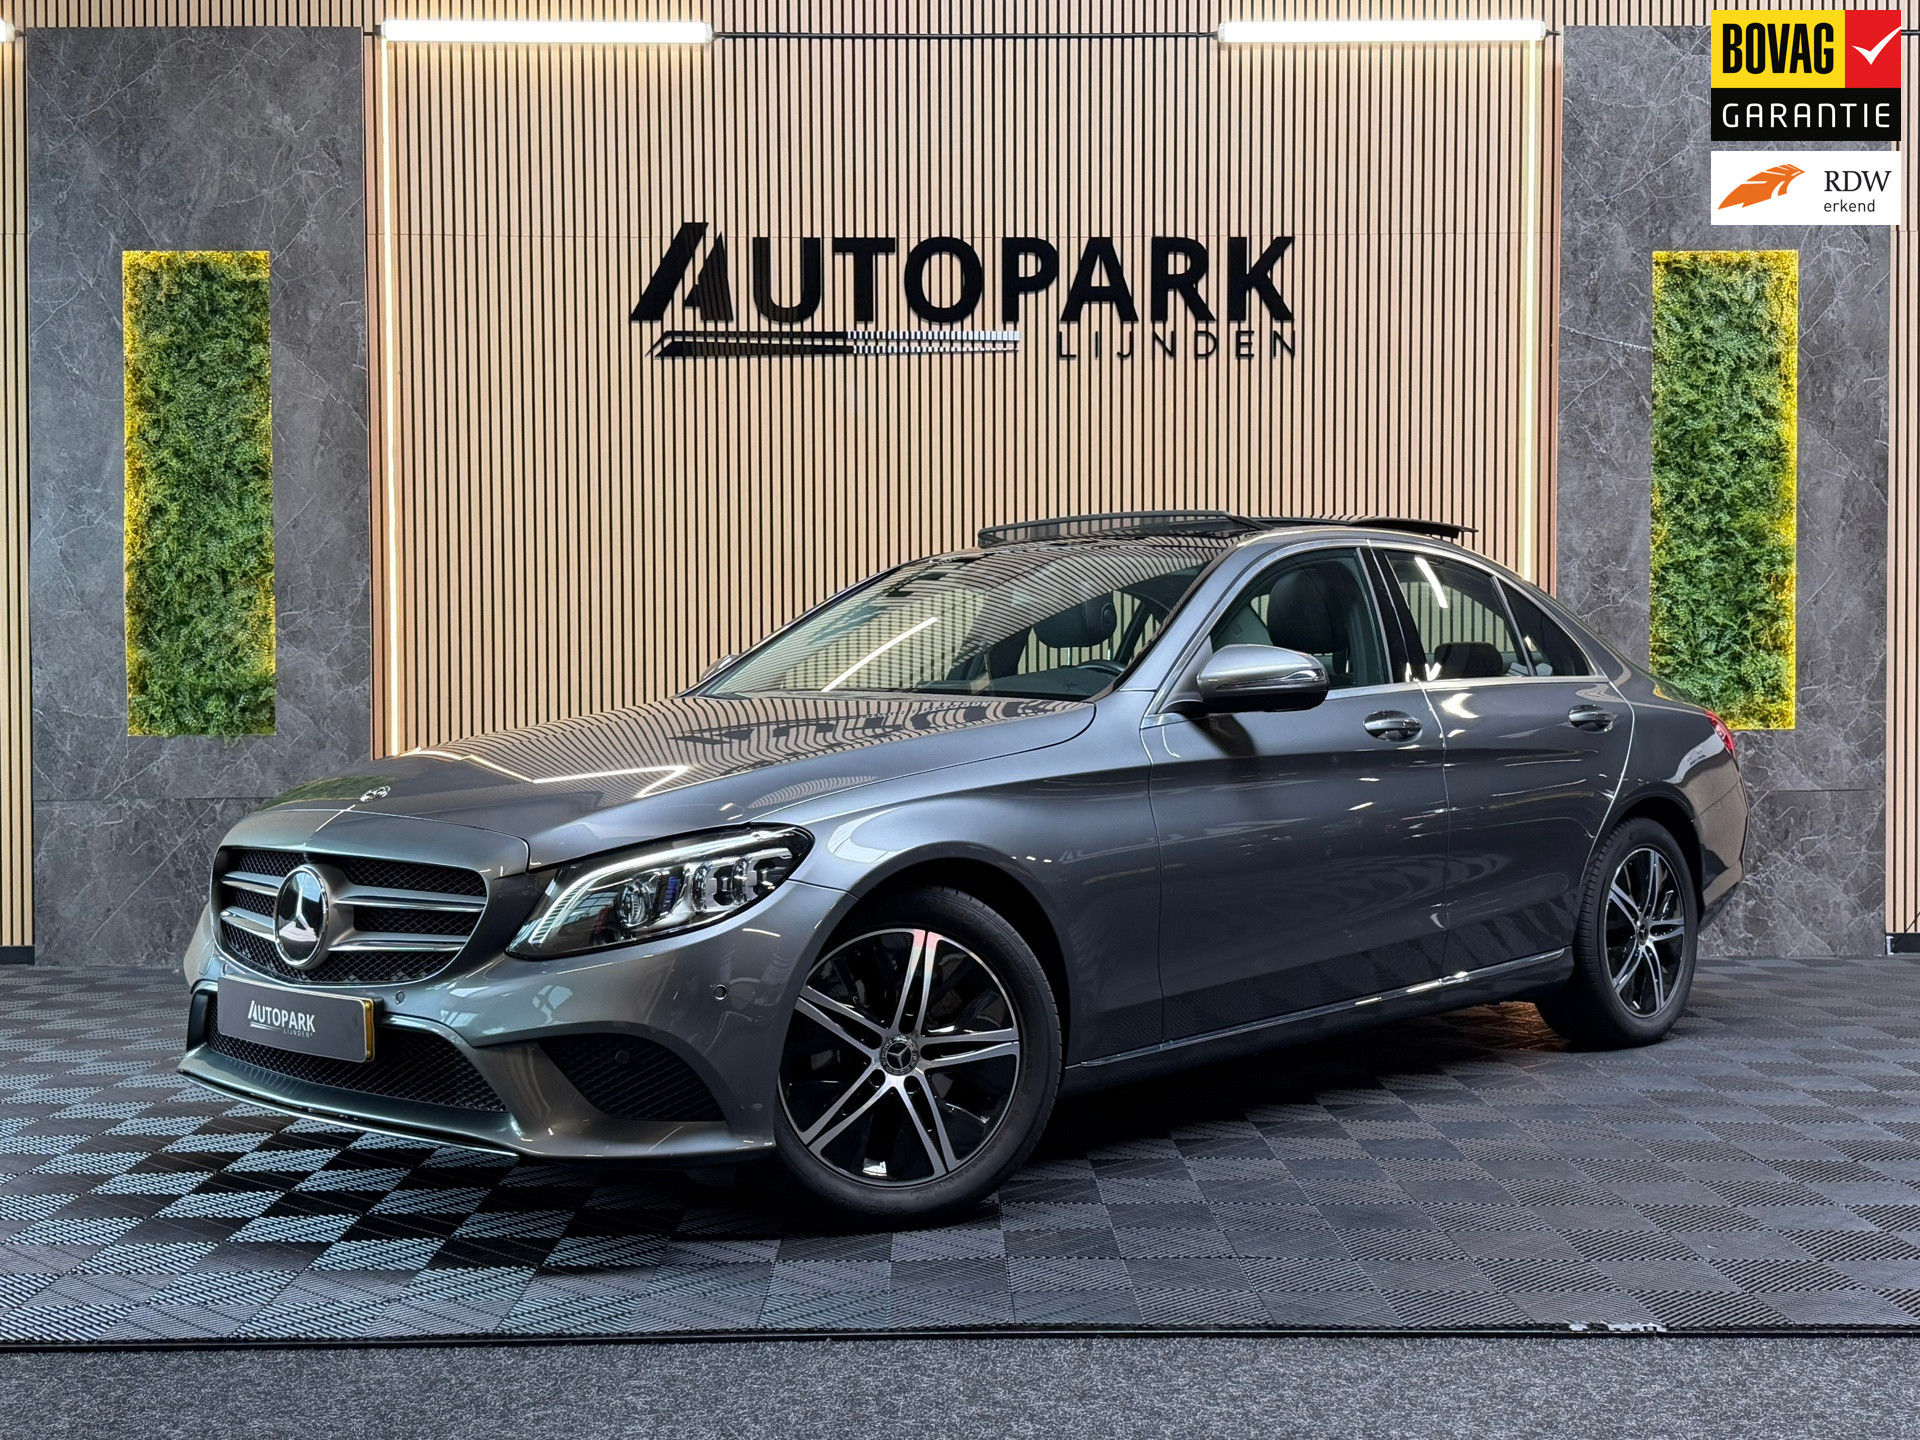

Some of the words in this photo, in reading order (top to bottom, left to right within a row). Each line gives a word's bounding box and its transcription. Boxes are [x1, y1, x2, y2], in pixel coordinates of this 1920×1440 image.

[629, 221, 1295, 324] AUTOPARK
[1057, 330, 1296, 359] LIJNDEN
[247, 1000, 316, 1033] AUTOPARK
